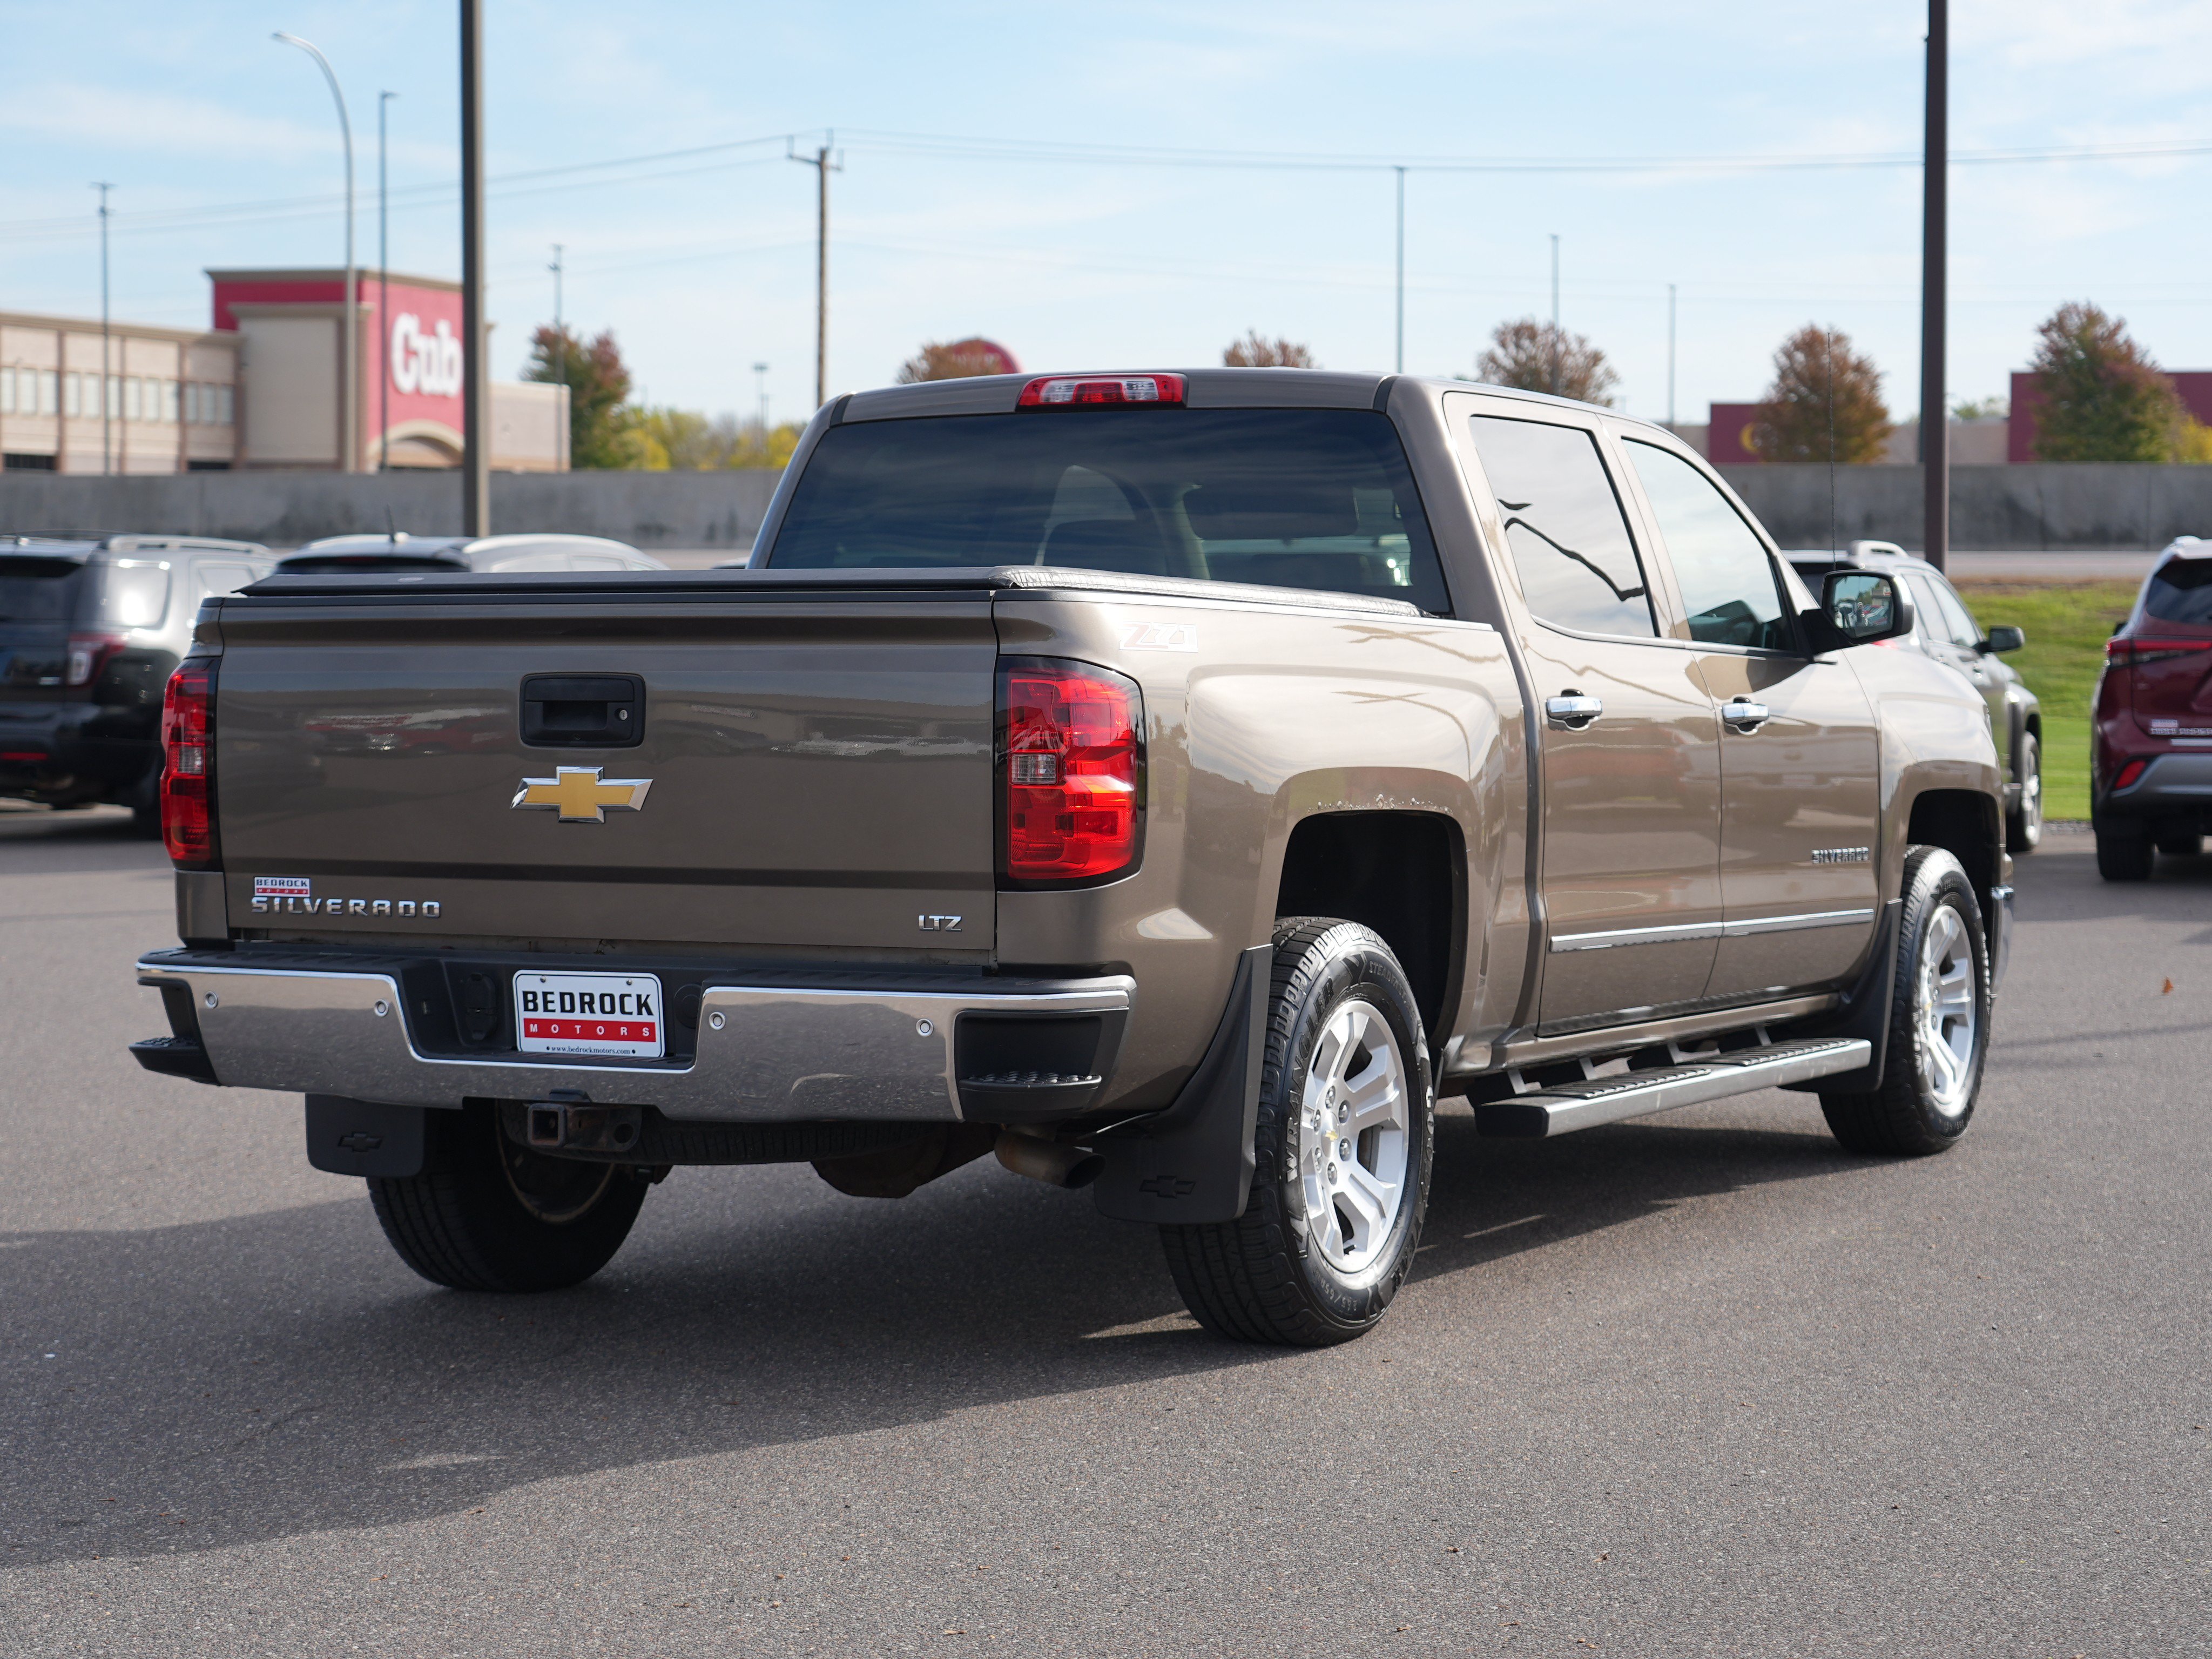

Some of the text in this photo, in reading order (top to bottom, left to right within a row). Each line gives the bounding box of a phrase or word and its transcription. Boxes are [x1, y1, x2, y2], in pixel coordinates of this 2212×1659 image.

[391, 312, 464, 398] Cub
[1119, 621, 1198, 653] Z71
[251, 896, 441, 918] SILVERADO
[919, 915, 962, 931] LTZ
[522, 990, 655, 1016] BEDROCK
[529, 1023, 650, 1037] MOTORS
[551, 1046, 631, 1055] www.bedrockmotors.com
[1286, 976, 1334, 1183] WRANGLER
